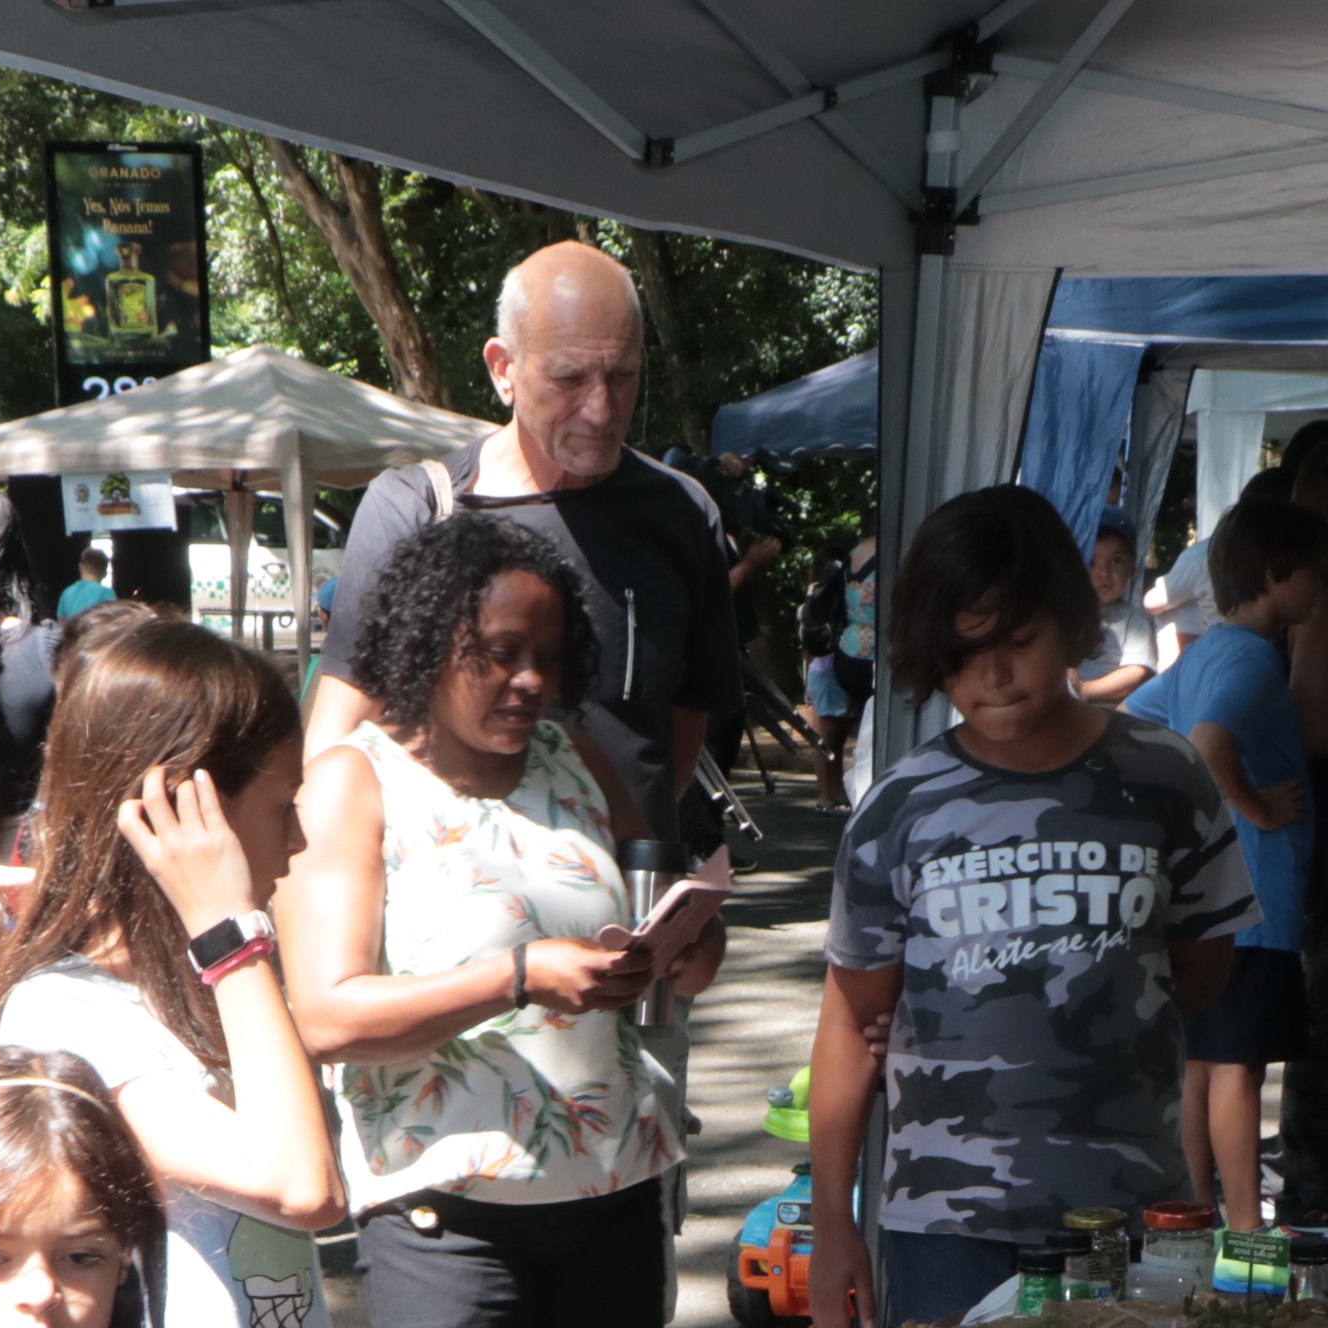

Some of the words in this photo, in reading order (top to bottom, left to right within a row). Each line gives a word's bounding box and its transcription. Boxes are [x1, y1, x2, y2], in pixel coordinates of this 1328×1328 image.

[88, 167, 162, 179] GRANADO
[134, 198, 170, 216] Temos
[102, 218, 153, 236] Banana!
[923, 841, 1107, 889] EXÉRCITO
[1119, 843, 1158, 875] DE
[927, 873, 1156, 939] CRISTO
[951, 935, 1087, 980] Aliste-se
